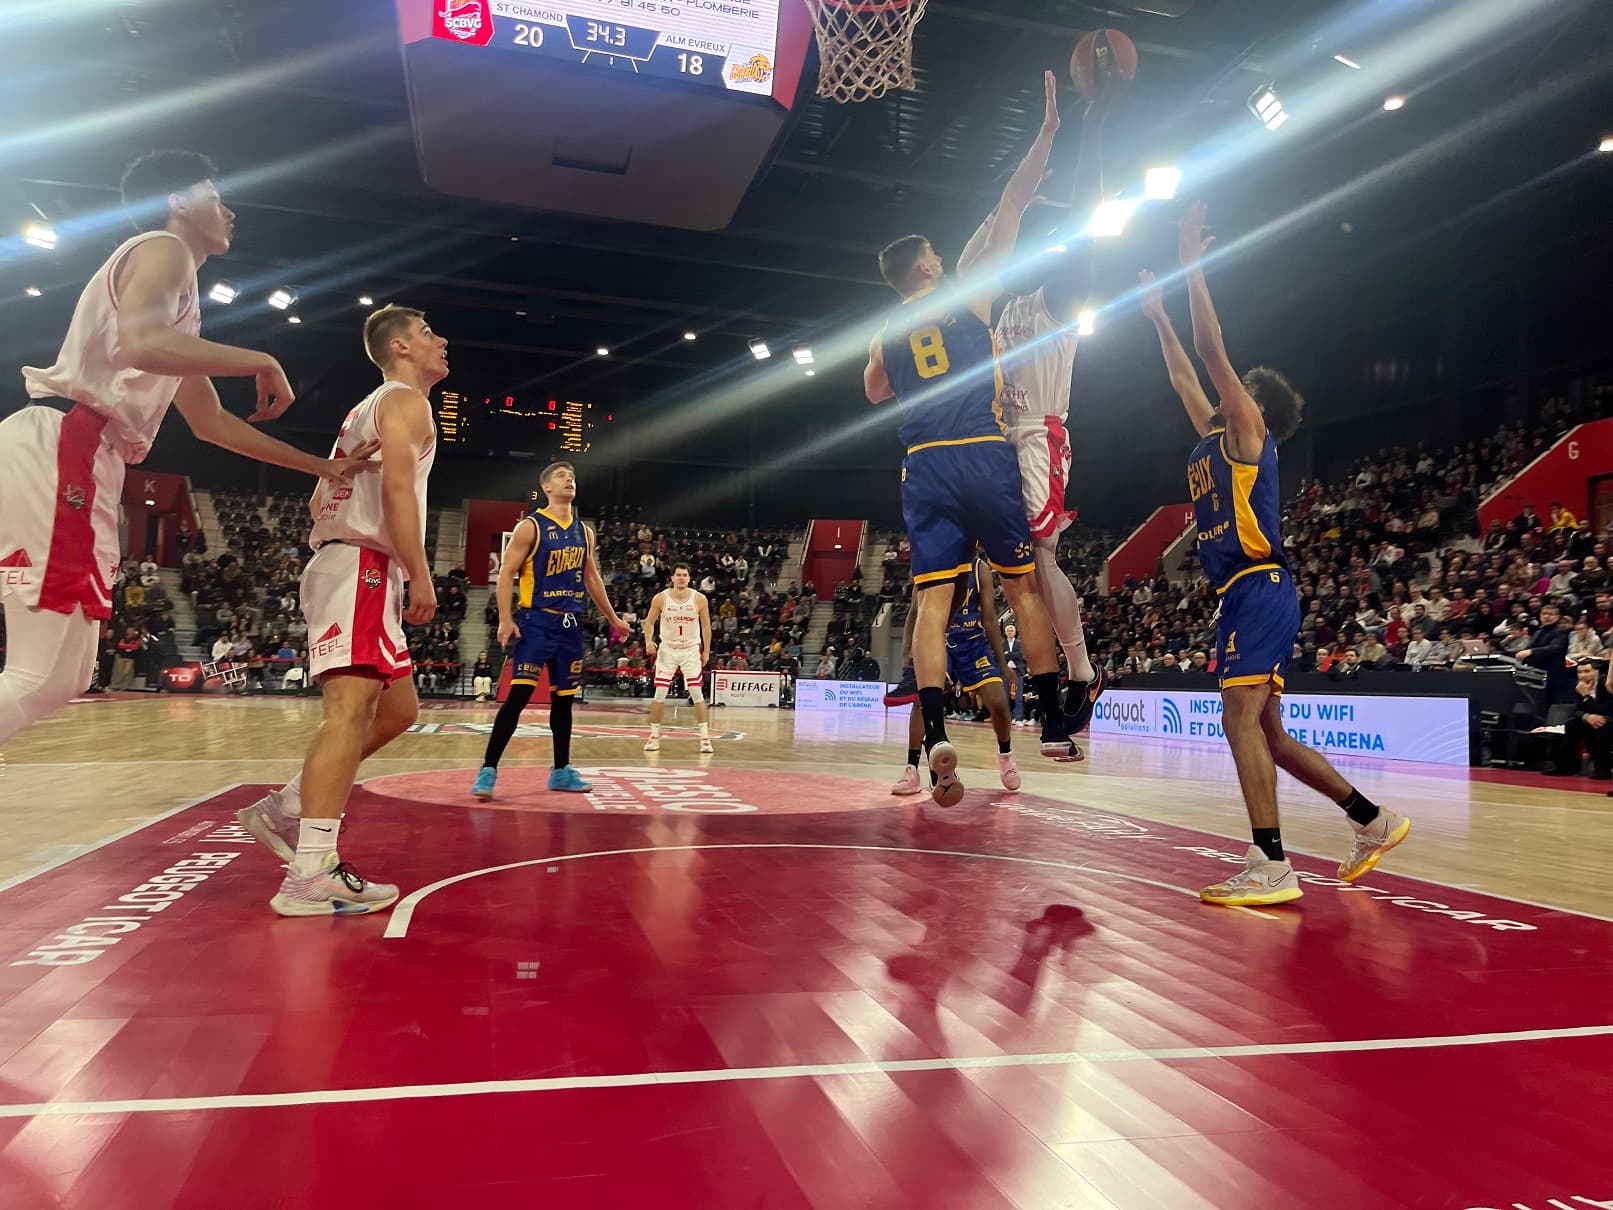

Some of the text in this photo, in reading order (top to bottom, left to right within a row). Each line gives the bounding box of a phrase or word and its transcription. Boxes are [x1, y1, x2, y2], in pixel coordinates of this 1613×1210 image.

[496, 3, 563, 22] ST CHAMOND
[638, 2, 656, 11] 45
[661, 5, 681, 16] 50
[687, 0, 760, 19] PLOMBERIE
[444, 17, 482, 29] SCBVG
[513, 24, 544, 48] 20
[586, 22, 627, 46] 34.3
[665, 34, 725, 53] ALM EVREUX
[677, 53, 704, 75] 18
[909, 326, 950, 379] 8
[1568, 441, 1579, 460] G
[144, 480, 156, 493] K
[1212, 493, 1219, 511] 6
[1184, 511, 1193, 525] H
[1269, 571, 1281, 584] 6
[678, 625, 683, 636] 1
[730, 681, 774, 693] EIFFAGE
[1095, 696, 1145, 727] adquat
[1290, 703, 1311, 719] DU
[1317, 704, 1354, 721] WIFI
[1120, 723, 1150, 732] solutions
[1189, 721, 1385, 751] ET DU DE L'ARENA
[10, 852, 242, 967] PEUGEOT ICAR
[1370, 895, 1538, 931] ICAR
